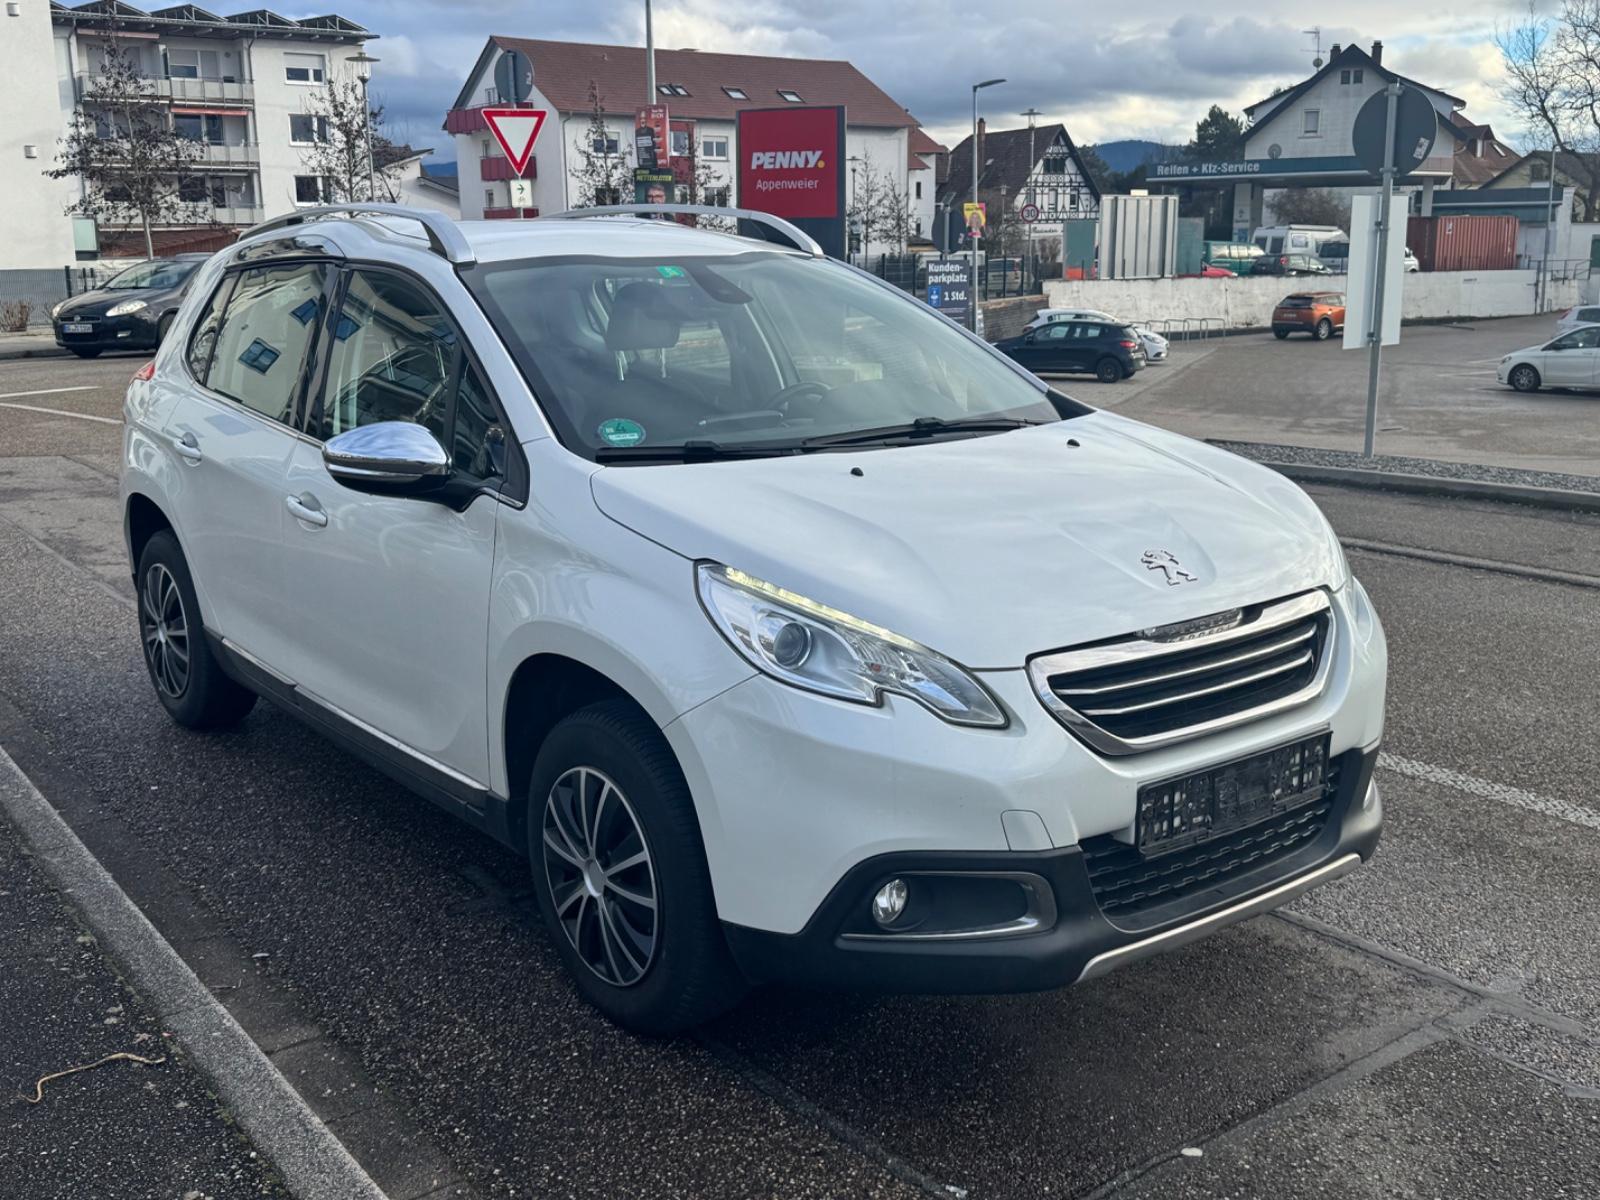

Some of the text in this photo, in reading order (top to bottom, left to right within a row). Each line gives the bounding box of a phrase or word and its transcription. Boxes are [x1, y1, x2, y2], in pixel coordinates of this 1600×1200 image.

[1157, 164, 1189, 176] Reifen
[1201, 162, 1260, 174] Kfz-Service
[756, 178, 819, 192] Appenweier
[1025, 208, 1036, 218] 30
[928, 262, 964, 272] Kunden-
[928, 273, 968, 285] parkplatz
[944, 290, 968, 301] 1 Std.
